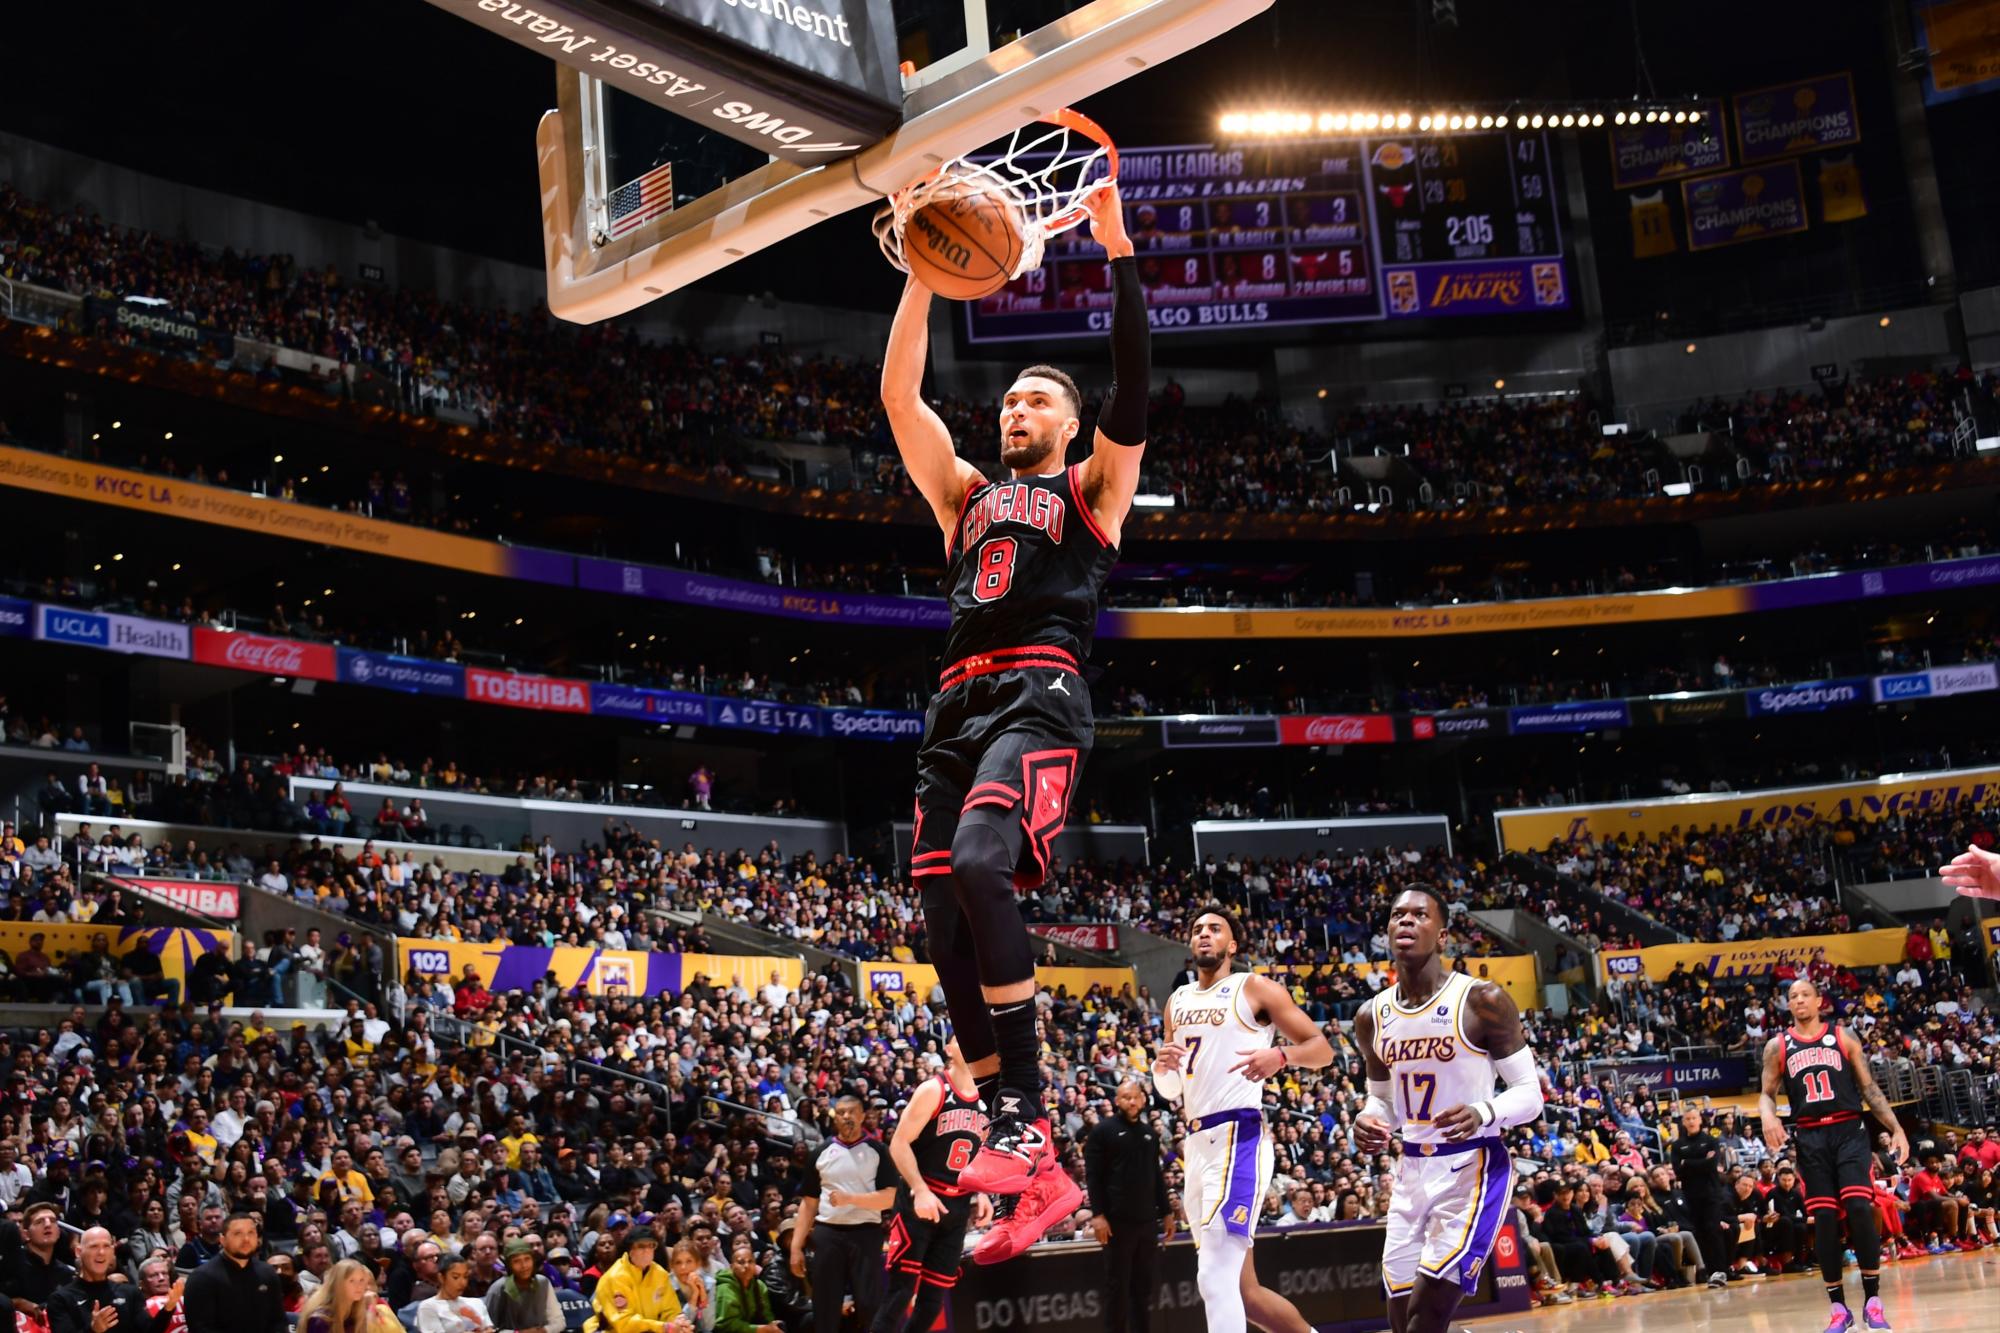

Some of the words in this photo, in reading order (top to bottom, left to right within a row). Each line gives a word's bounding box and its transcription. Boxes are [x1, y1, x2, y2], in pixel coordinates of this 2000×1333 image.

[722, 0, 852, 47] ment
[589, 46, 706, 97] Asset
[712, 101, 813, 144] DWS
[1745, 111, 1849, 145] CHAMPIONS
[1518, 139, 1536, 162] 47
[1619, 137, 1721, 169] CHAMPIONS
[1086, 154, 1162, 181] SCRING
[1167, 151, 1244, 179] LEADERS
[1202, 177, 1306, 197] LAKERS
[1179, 206, 1192, 230] 8
[1256, 202, 1270, 227] 3
[1333, 198, 1347, 223] 3
[1695, 198, 1797, 231] CHAMPIONS
[1445, 213, 1494, 246] 2:05
[1184, 258, 1198, 283] 8
[1262, 254, 1276, 280] 8
[1338, 250, 1352, 276] 5
[1430, 274, 1523, 307] LAKERS
[116, 306, 198, 340] Spectrum
[1088, 304, 1190, 330] CHAGO
[1198, 302, 1269, 324] BULLS
[95, 475, 143, 500] KYCC
[149, 485, 172, 504] LA
[963, 484, 1066, 556] CHICAGO
[972, 536, 1018, 603] 8
[685, 580, 768, 607] Congratulations
[783, 595, 817, 613] KYCC
[820, 601, 840, 615] LA
[52, 616, 103, 639] UCLA
[115, 624, 183, 652] Health
[1392, 613, 1428, 630] KYCC
[1432, 612, 1450, 628] LA
[374, 664, 454, 686] crypto.com
[1886, 679, 1927, 696] UCLA
[1936, 671, 1993, 692] Health
[471, 672, 586, 708] TOSHIBA
[1760, 685, 1854, 713] Spectrum
[656, 699, 704, 717] ULTRA
[742, 706, 813, 730] DELTA
[1517, 713, 1572, 726] AMERICAN
[1574, 710, 1622, 722] EXPRESS
[832, 712, 920, 735] Spectrum
[1437, 718, 1490, 732] TOYOTA
[1737, 801, 1816, 829] LOS
[1827, 783, 2000, 821] ANGELE
[126, 883, 237, 914] SHIBA
[412, 951, 448, 972] 102
[1609, 958, 1639, 973] 105
[1731, 951, 1757, 961] LOS
[1761, 946, 1825, 959] ANGELES
[872, 972, 901, 990] 103
[1172, 1007, 1228, 1033] LAKERS
[1431, 1016, 1453, 1026] bibigo
[1185, 1035, 1202, 1080] 7
[1379, 1035, 1457, 1070] LAKERS
[1786, 1046, 1842, 1079] CHICAGO
[1674, 1067, 1722, 1083] ULTRA
[1802, 1070, 1835, 1103] 11
[1400, 1072, 1437, 1126] 17
[936, 1108, 991, 1140] CHICAG
[945, 1138, 974, 1171] 6
[1278, 1266, 1331, 1296] BOOK
[1337, 1261, 1382, 1289] VEGA
[1495, 1274, 1527, 1289] TOYOTA
[560, 1300, 591, 1310] ELTA
[975, 1298, 1012, 1330] DO
[1017, 1289, 1100, 1325] VEGAS
